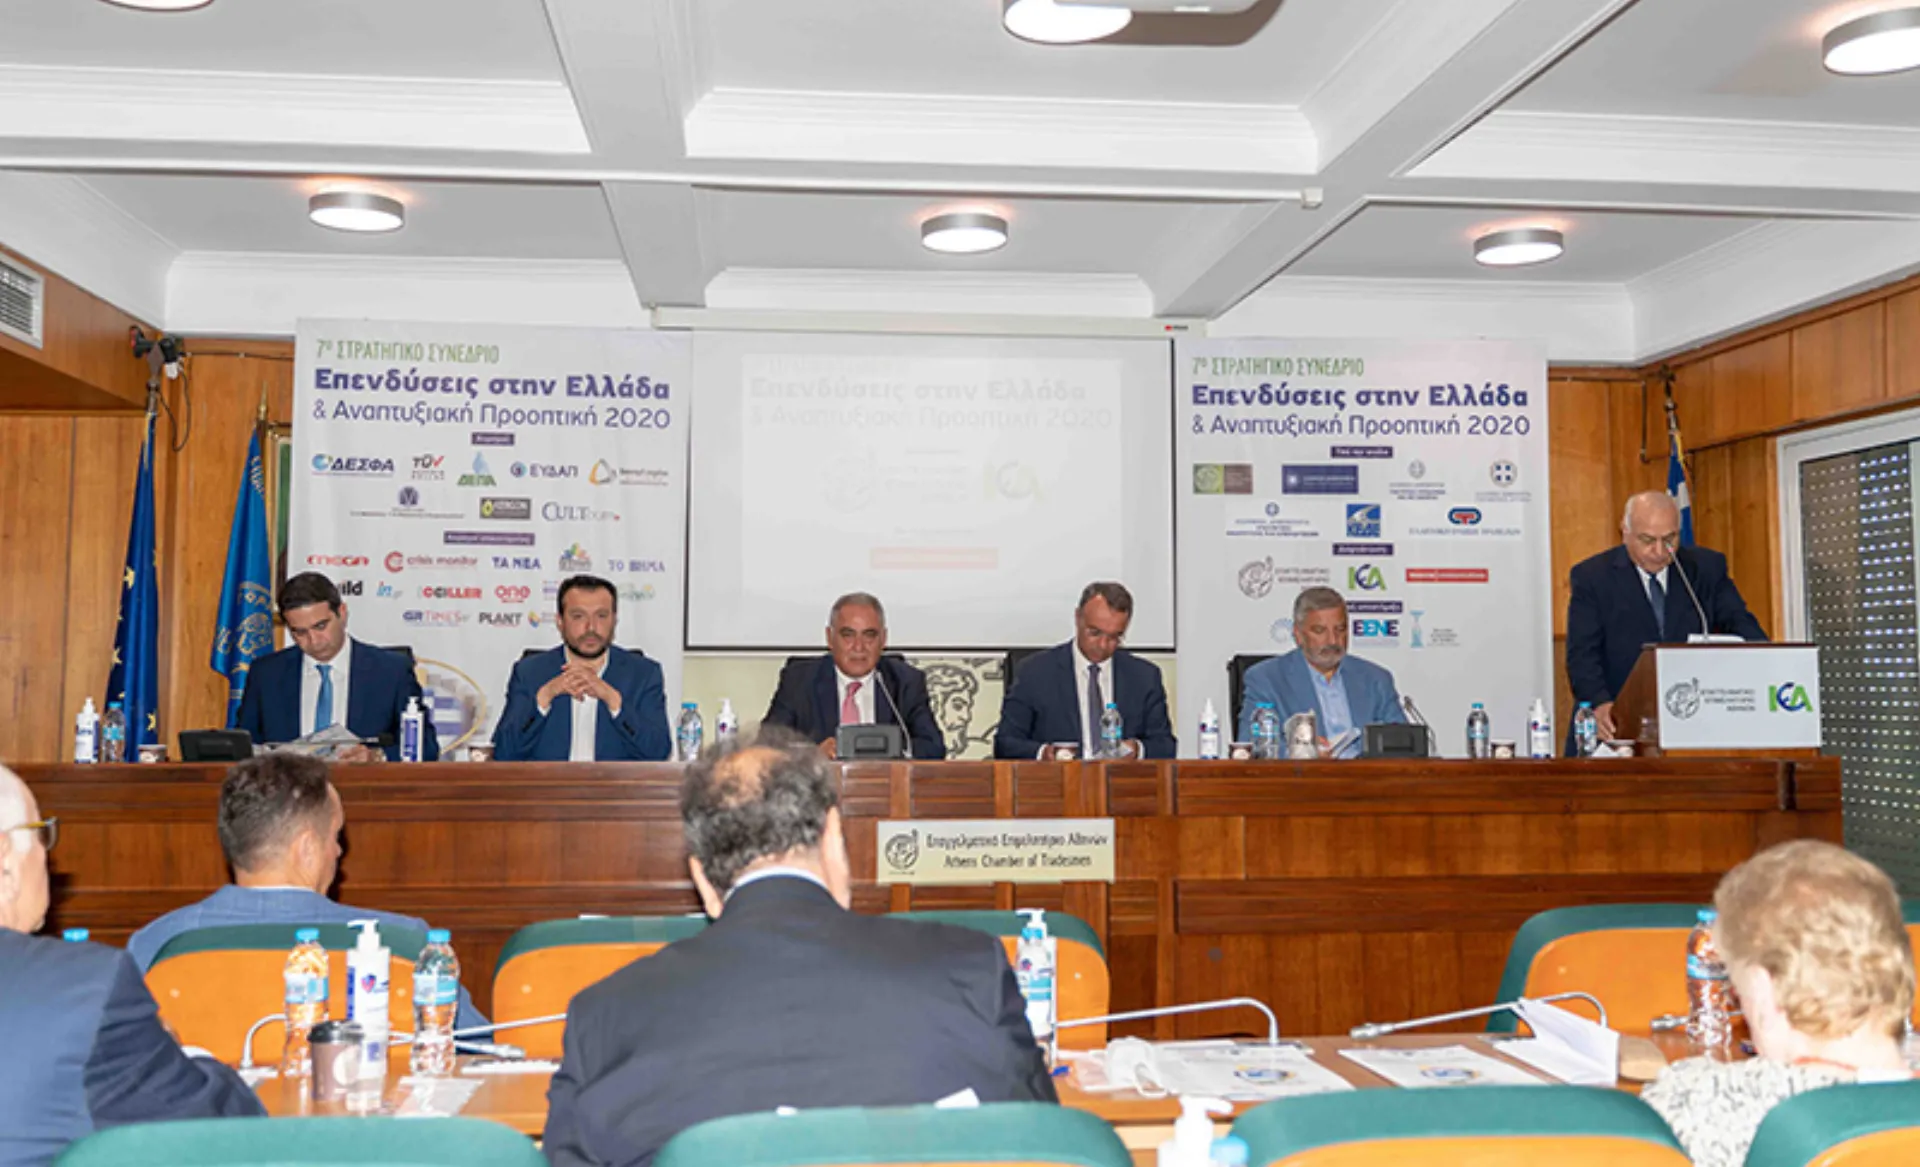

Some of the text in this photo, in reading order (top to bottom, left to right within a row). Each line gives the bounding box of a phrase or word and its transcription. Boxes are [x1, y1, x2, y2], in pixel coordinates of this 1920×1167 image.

[336, 340, 424, 362] ΣΤΡΑΤΗΓΙΚΟ
[429, 343, 499, 364] ΣΥΝΕΔΡΙΟ
[1211, 358, 1293, 377] ΣΤΡΑΤΗΓΙΚΟ
[1296, 357, 1364, 377] ΣΥΝΕΔΡΙΟ
[314, 367, 671, 400] Επενδύσεις στην Ελλάδα
[1192, 381, 1528, 410] Επενδύσεις στην Ελλάδα
[313, 397, 671, 430] & Αναπτυξιακή Προοπτική 2020
[1192, 414, 1531, 439] & Αναπτυξιακή Προοπτική 2020
[330, 457, 395, 471] ΔΕΣΦΑ
[529, 463, 579, 478] ΕΥΔΑΠ
[479, 612, 523, 625] PLANT
[943, 854, 978, 869] Athens
[981, 854, 1024, 869] Chamber
[1027, 853, 1039, 868] of
